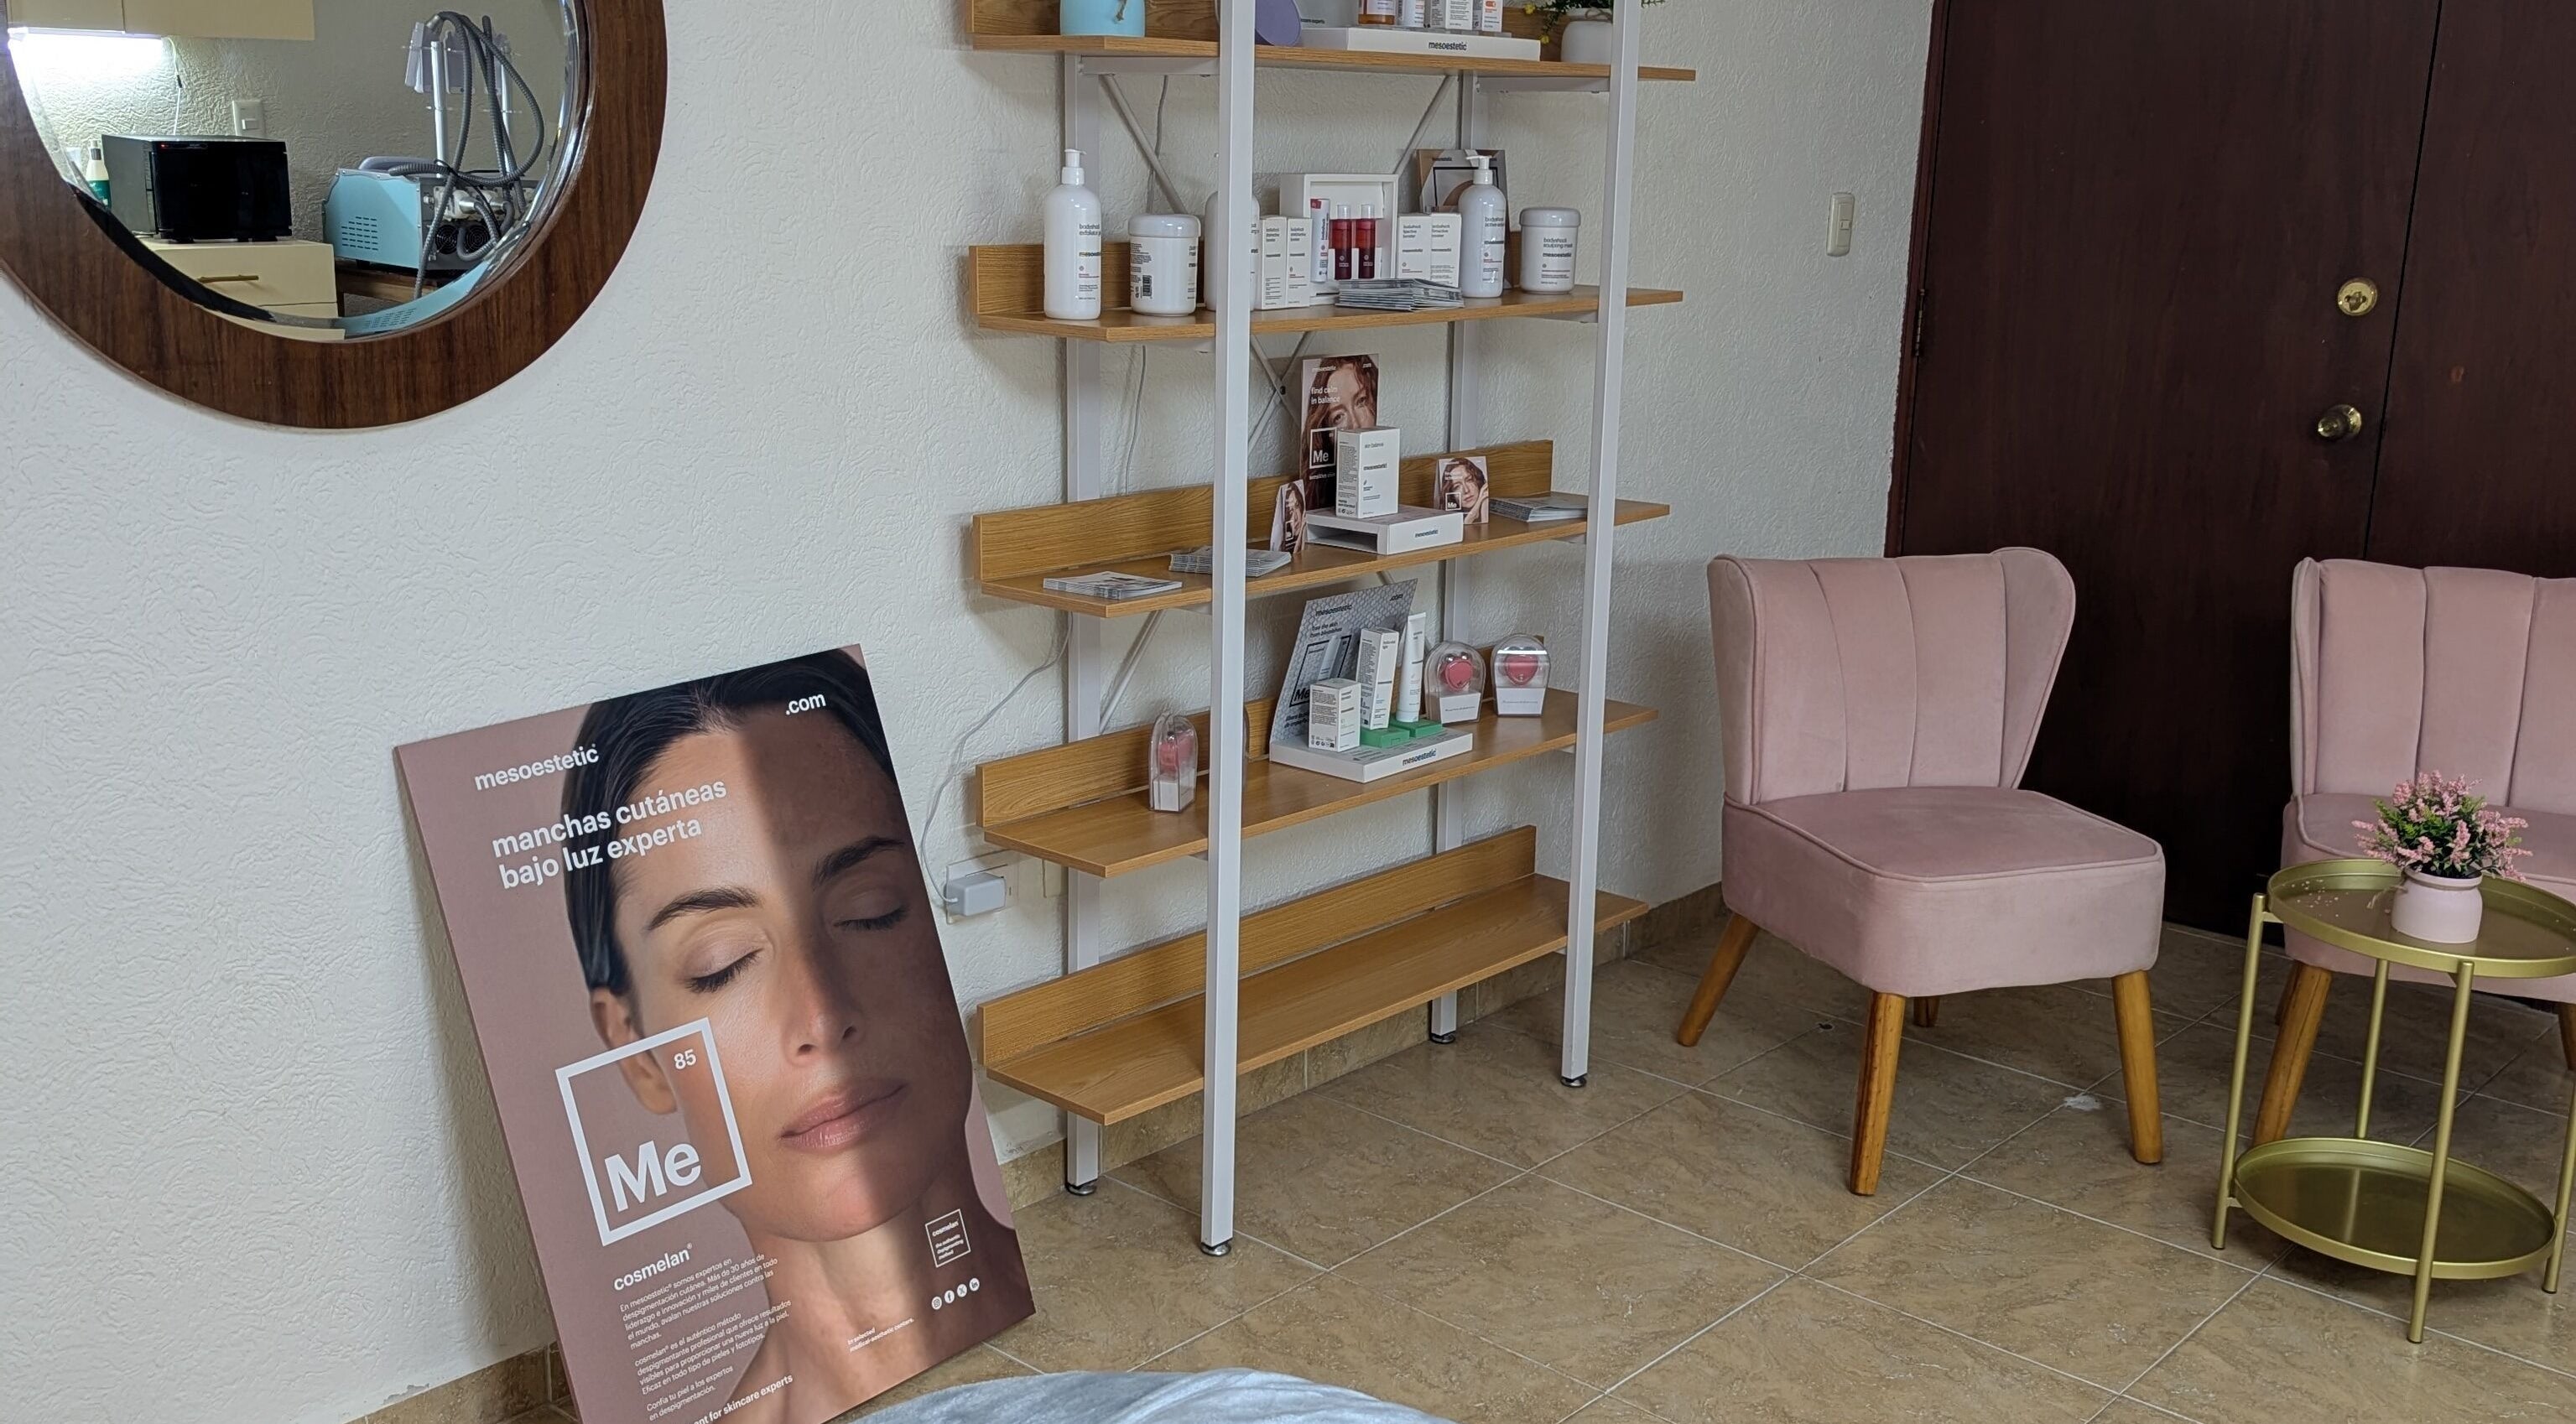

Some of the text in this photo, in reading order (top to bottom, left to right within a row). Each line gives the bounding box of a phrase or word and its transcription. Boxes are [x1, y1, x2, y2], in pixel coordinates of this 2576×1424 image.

[1311, 387, 1323, 395] find
[1311, 396, 1340, 405] in balance
[1313, 450, 1329, 463] Me
[1315, 604, 1353, 617] mesoestetic
[785, 693, 826, 716] .com
[1402, 748, 1437, 767] mesoestetic
[492, 780, 727, 858] manchas cutáneas
[499, 818, 702, 890] bajo luz experta
[674, 1049, 697, 1070] 85
[604, 1140, 701, 1213] Me
[620, 1304, 629, 1312] En
[674, 1276, 695, 1289] somos
[695, 1263, 722, 1281] expertos
[723, 1259, 732, 1267] en
[623, 1291, 679, 1322] despigmentación
[707, 1275, 721, 1283] Más
[731, 1265, 740, 1273] 30
[756, 1254, 764, 1262] de
[625, 1314, 656, 1331] liderazgo
[661, 1295, 696, 1315] innovación
[703, 1285, 720, 1297] miles
[720, 1279, 728, 1287] de
[729, 1269, 753, 1284] clientes
[762, 1258, 778, 1271] todo
[628, 1332, 634, 1340] el
[661, 1312, 681, 1326] avalan
[683, 1300, 709, 1317] nuestras
[710, 1284, 743, 1302] soluciones
[744, 1275, 764, 1286] contra
[764, 1270, 773, 1279] las
[631, 1333, 662, 1350] manchas.
[637, 1300, 792, 1376] despigmentante profesional que ofrece resultados
[640, 1370, 664, 1385] visibles
[664, 1364, 679, 1376] para
[679, 1343, 721, 1368] proporcionar
[722, 1337, 734, 1346] una
[734, 1327, 754, 1340] nueva
[754, 1323, 764, 1332] luz
[670, 1342, 679, 1350] es
[679, 1337, 685, 1346] el
[686, 1325, 716, 1343] auténtico
[716, 1312, 742, 1329] método
[642, 1381, 661, 1395] Eficaz
[663, 1377, 672, 1385] en
[672, 1368, 687, 1381] todo
[688, 1362, 701, 1375] tipo
[702, 1357, 710, 1366] de
[712, 1348, 730, 1364] pieles
[647, 1395, 669, 1411] Confía
[669, 1392, 677, 1401] tu
[678, 1385, 690, 1400] piel
[695, 1379, 705, 1388] los
[705, 1364, 733, 1384] expertos
[649, 1413, 658, 1421] en
[710, 1408, 723, 1422] for
[723, 1390, 760, 1415] skincare
[761, 1374, 793, 1396] experts
